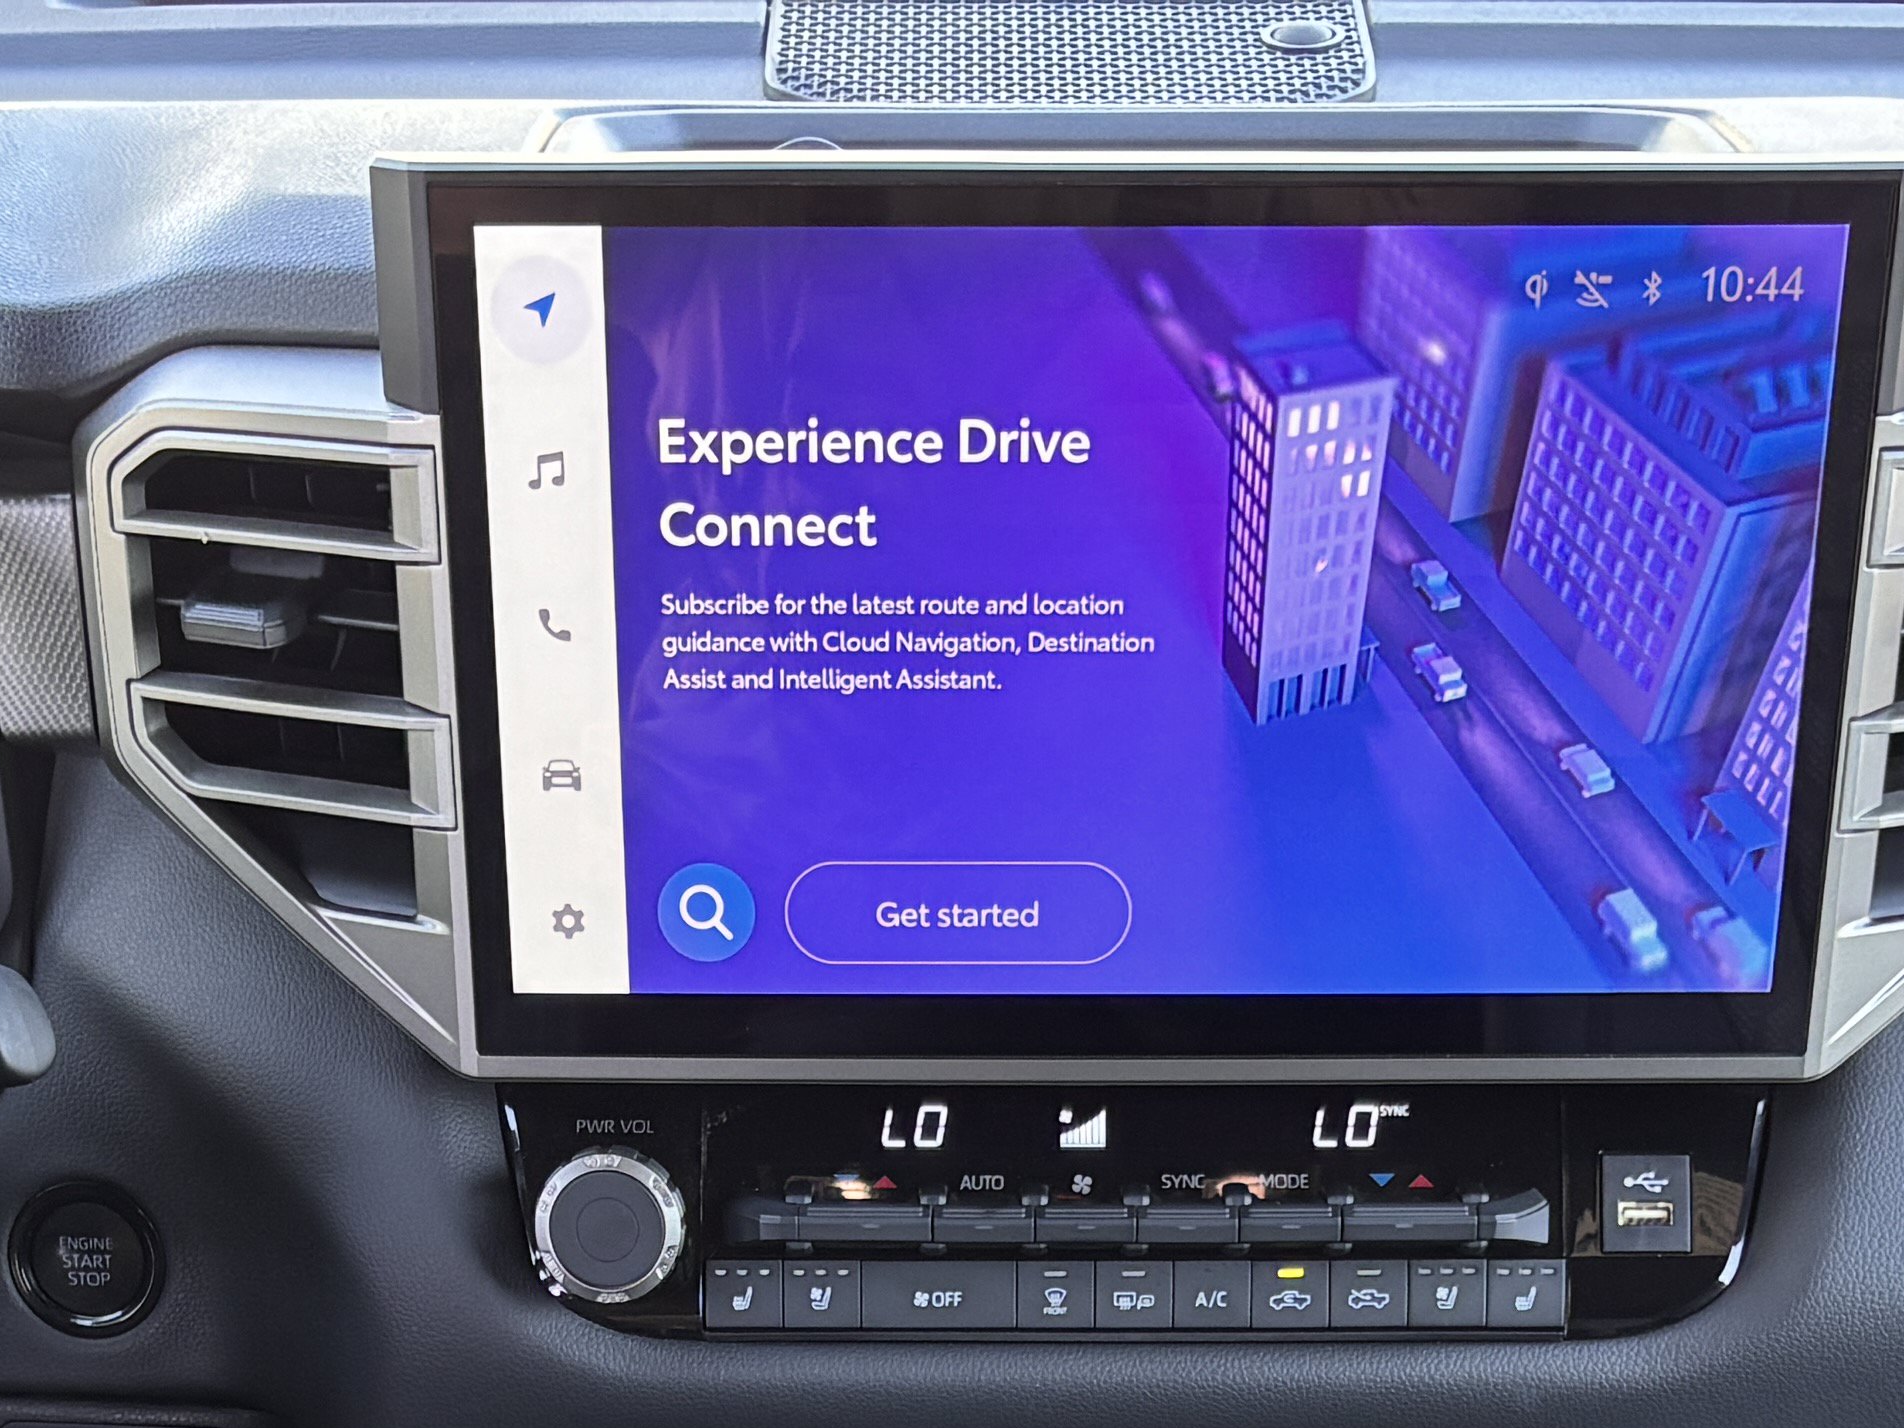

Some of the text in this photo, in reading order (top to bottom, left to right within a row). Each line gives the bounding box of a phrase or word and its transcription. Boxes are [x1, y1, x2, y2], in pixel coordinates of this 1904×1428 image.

[1701, 265, 1804, 302] 10:44
[658, 415, 1091, 476] Experience Drive
[659, 501, 878, 548] Connect
[661, 593, 1125, 616] Subscribe for the latest route and location
[662, 630, 1155, 657] guidance with Cloud Navigation, Destination
[663, 669, 1002, 695] Assist and Intelligent Assistant.
[875, 899, 1040, 931] Get started
[1380, 1104, 1411, 1118] SYNC
[576, 1119, 654, 1133] PWR VOL
[959, 1174, 1005, 1190] AUTO
[1160, 1174, 1205, 1190] SYNC
[1260, 1174, 1309, 1190] MODE
[58, 1236, 113, 1251] ENGINE
[62, 1254, 112, 1269] START
[68, 1271, 111, 1287] STOP
[932, 1291, 963, 1308] OFF
[1195, 1290, 1227, 1308] A/C
